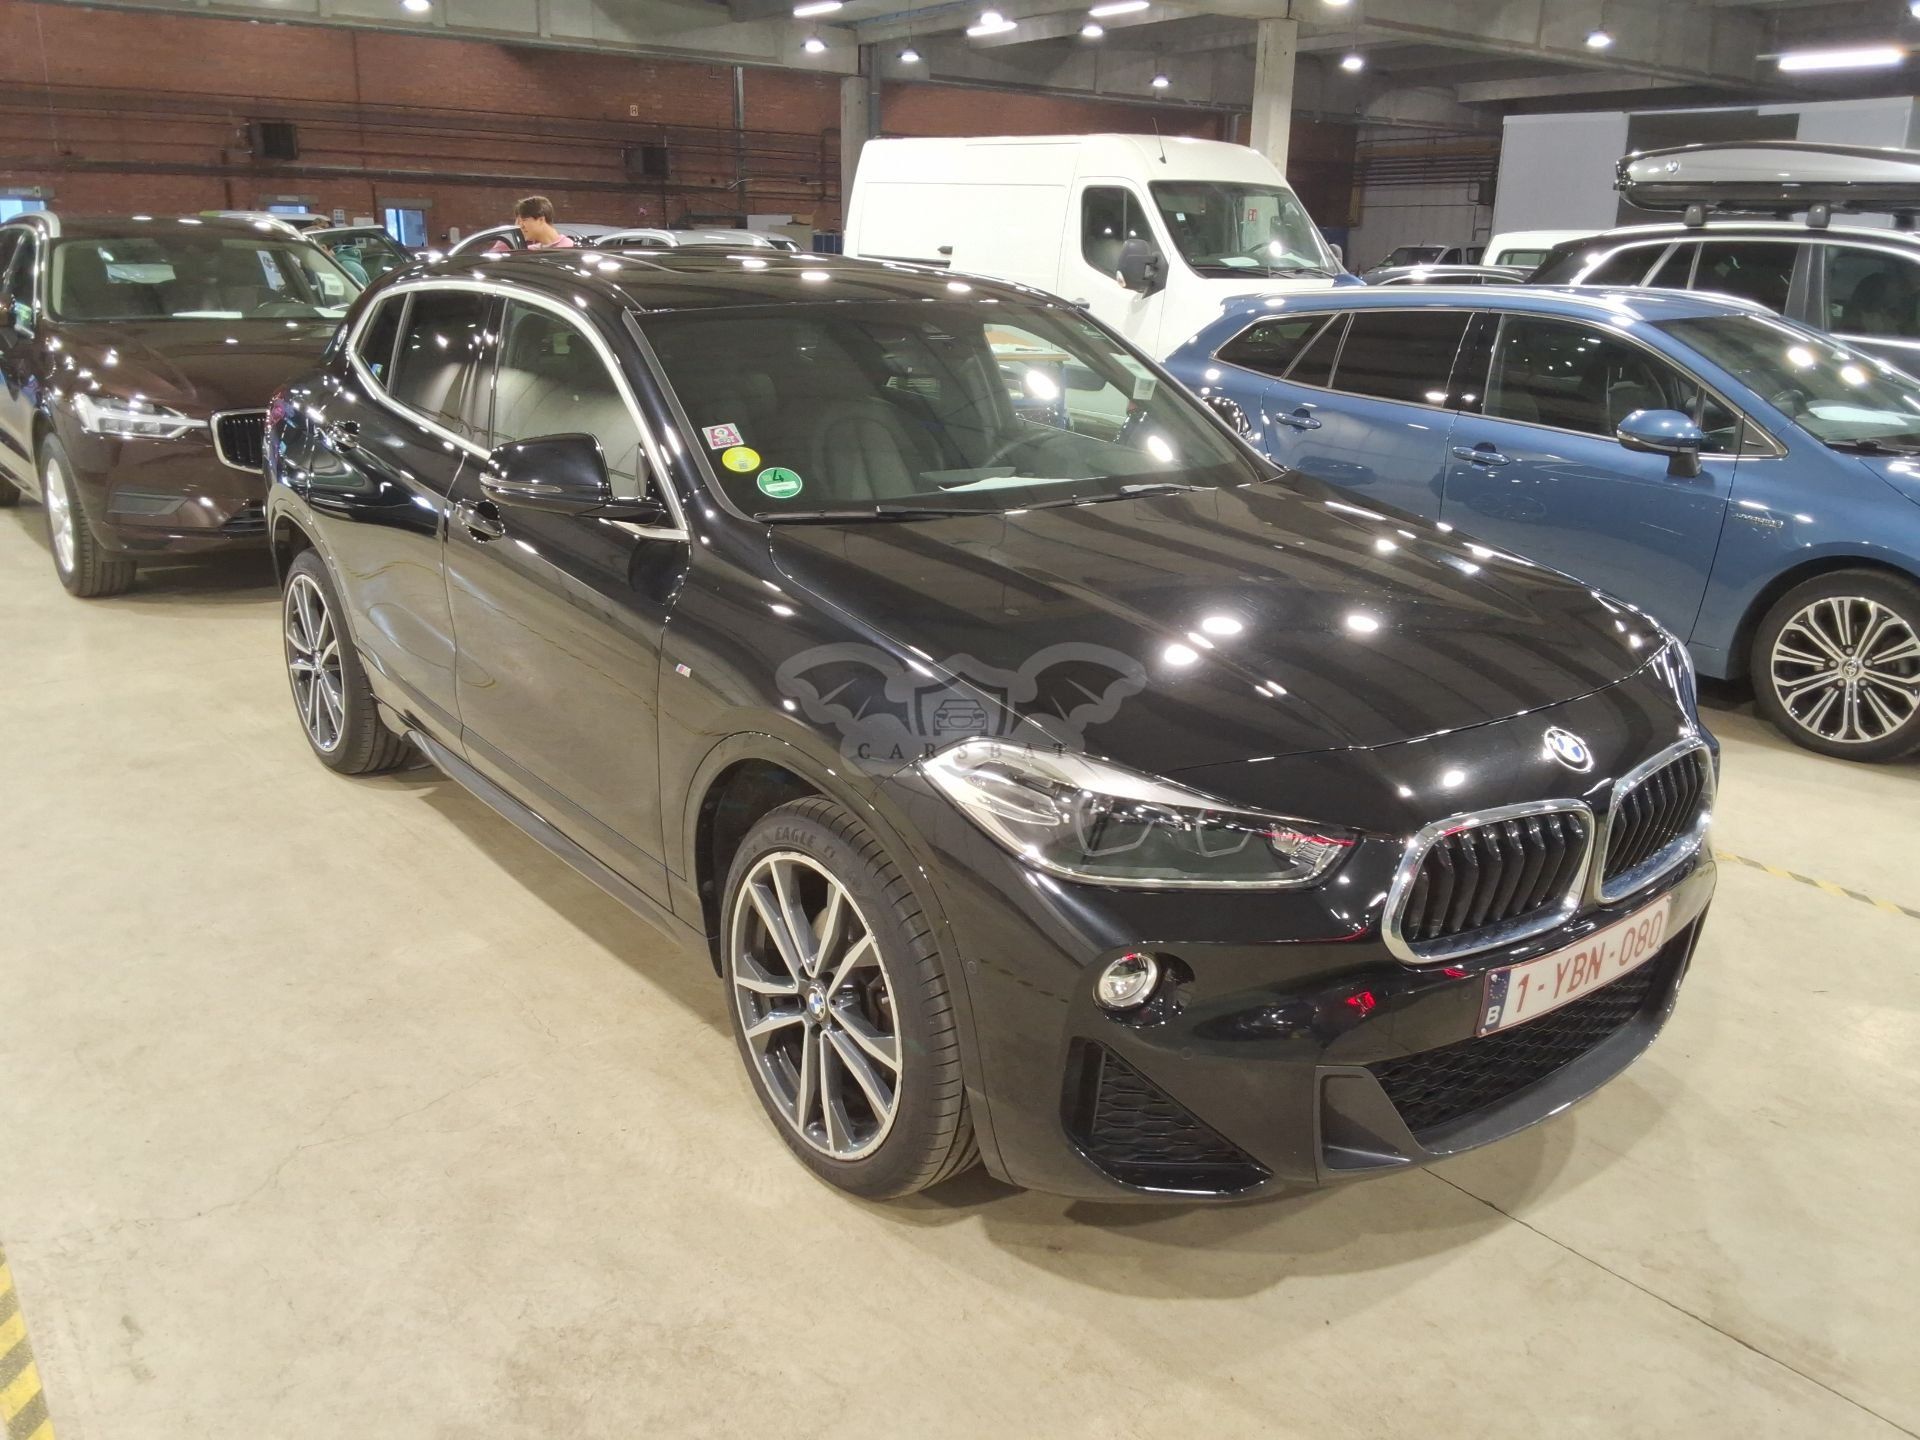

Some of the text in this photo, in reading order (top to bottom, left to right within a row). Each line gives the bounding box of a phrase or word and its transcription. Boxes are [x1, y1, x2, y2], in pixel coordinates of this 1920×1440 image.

[775, 826, 816, 847] EAGLE
[1516, 910, 1663, 1013] 1-YBN-080
[1484, 1005, 1500, 1025] B
